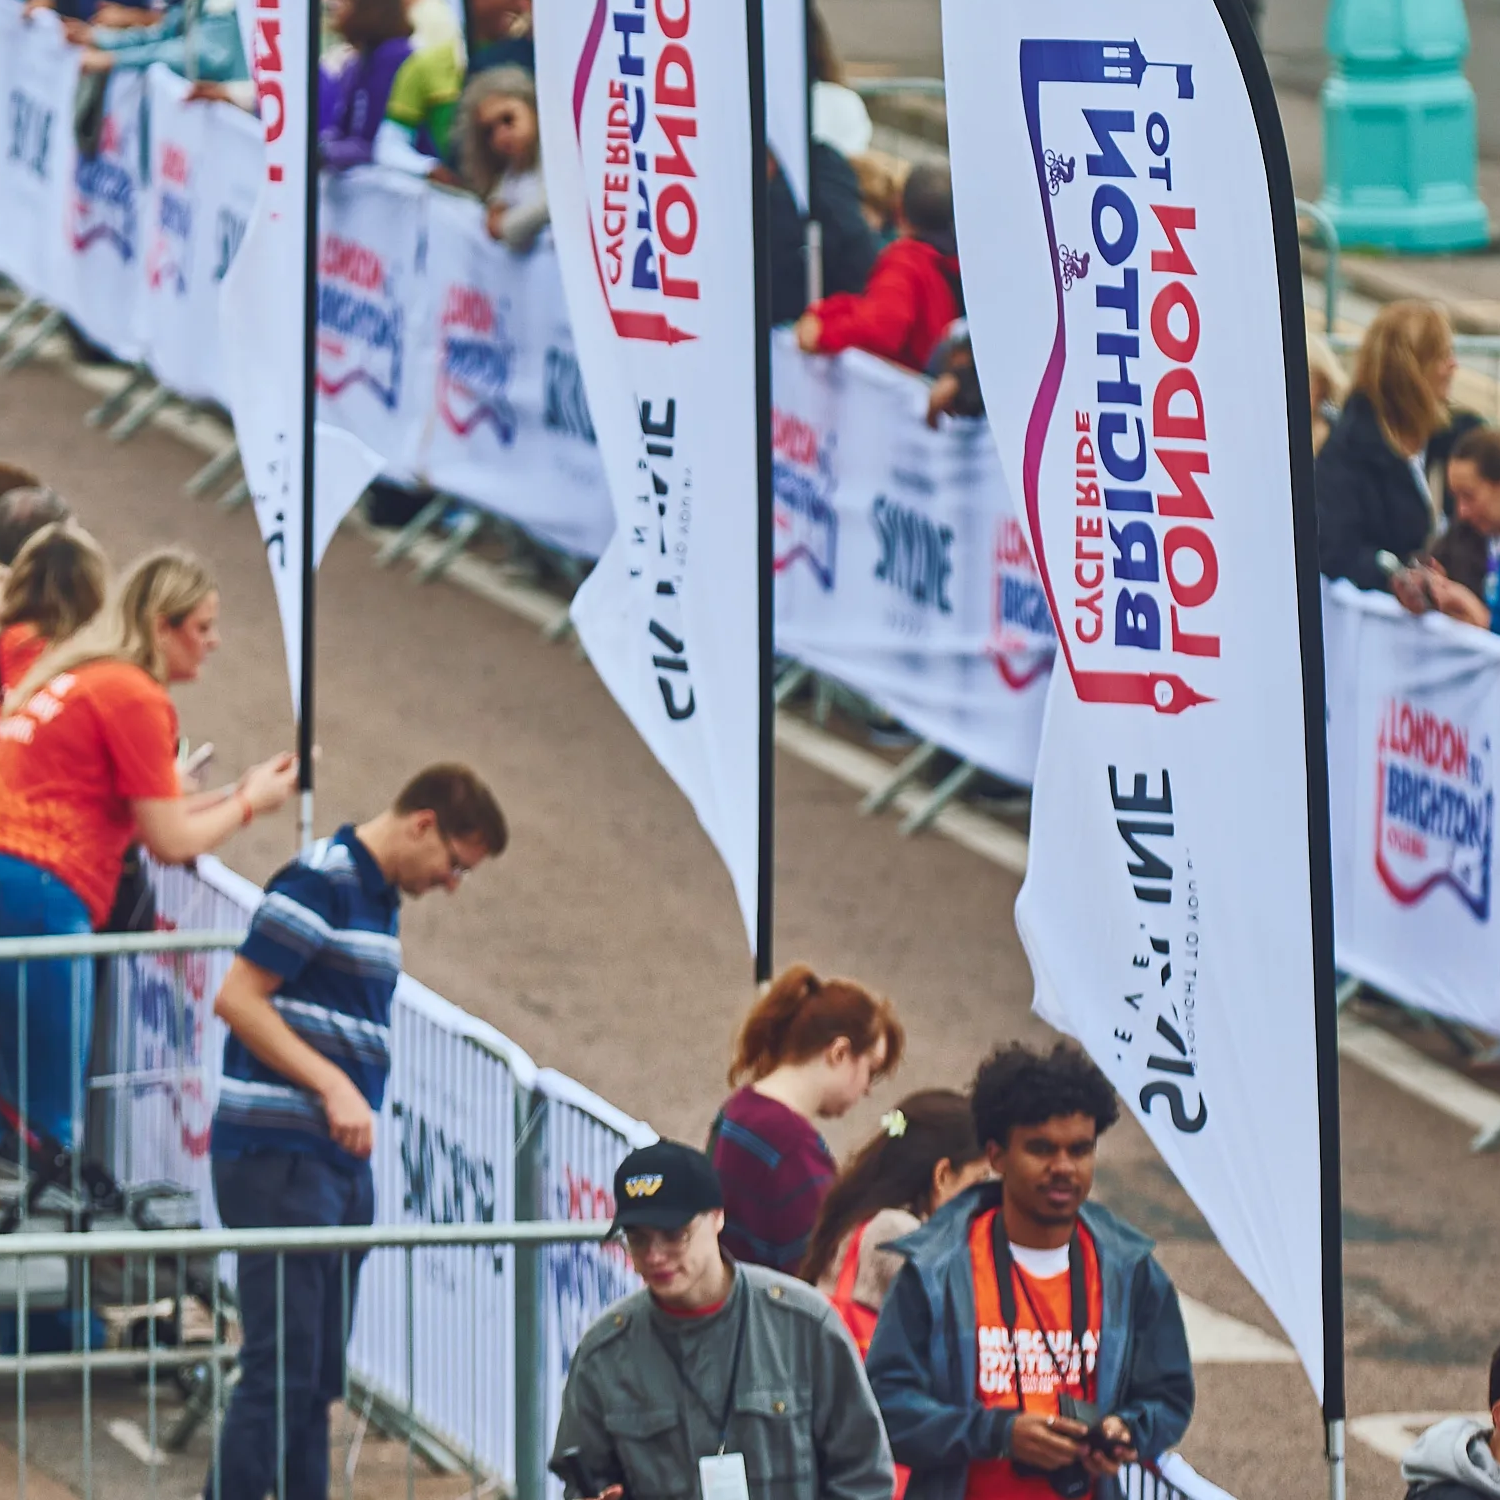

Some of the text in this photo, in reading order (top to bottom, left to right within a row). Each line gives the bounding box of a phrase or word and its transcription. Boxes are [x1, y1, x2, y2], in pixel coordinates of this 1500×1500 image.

[1389, 697, 1468, 778] LONDON
[1386, 761, 1482, 847] BRIGHTON
[979, 1371, 1012, 1394] UK
